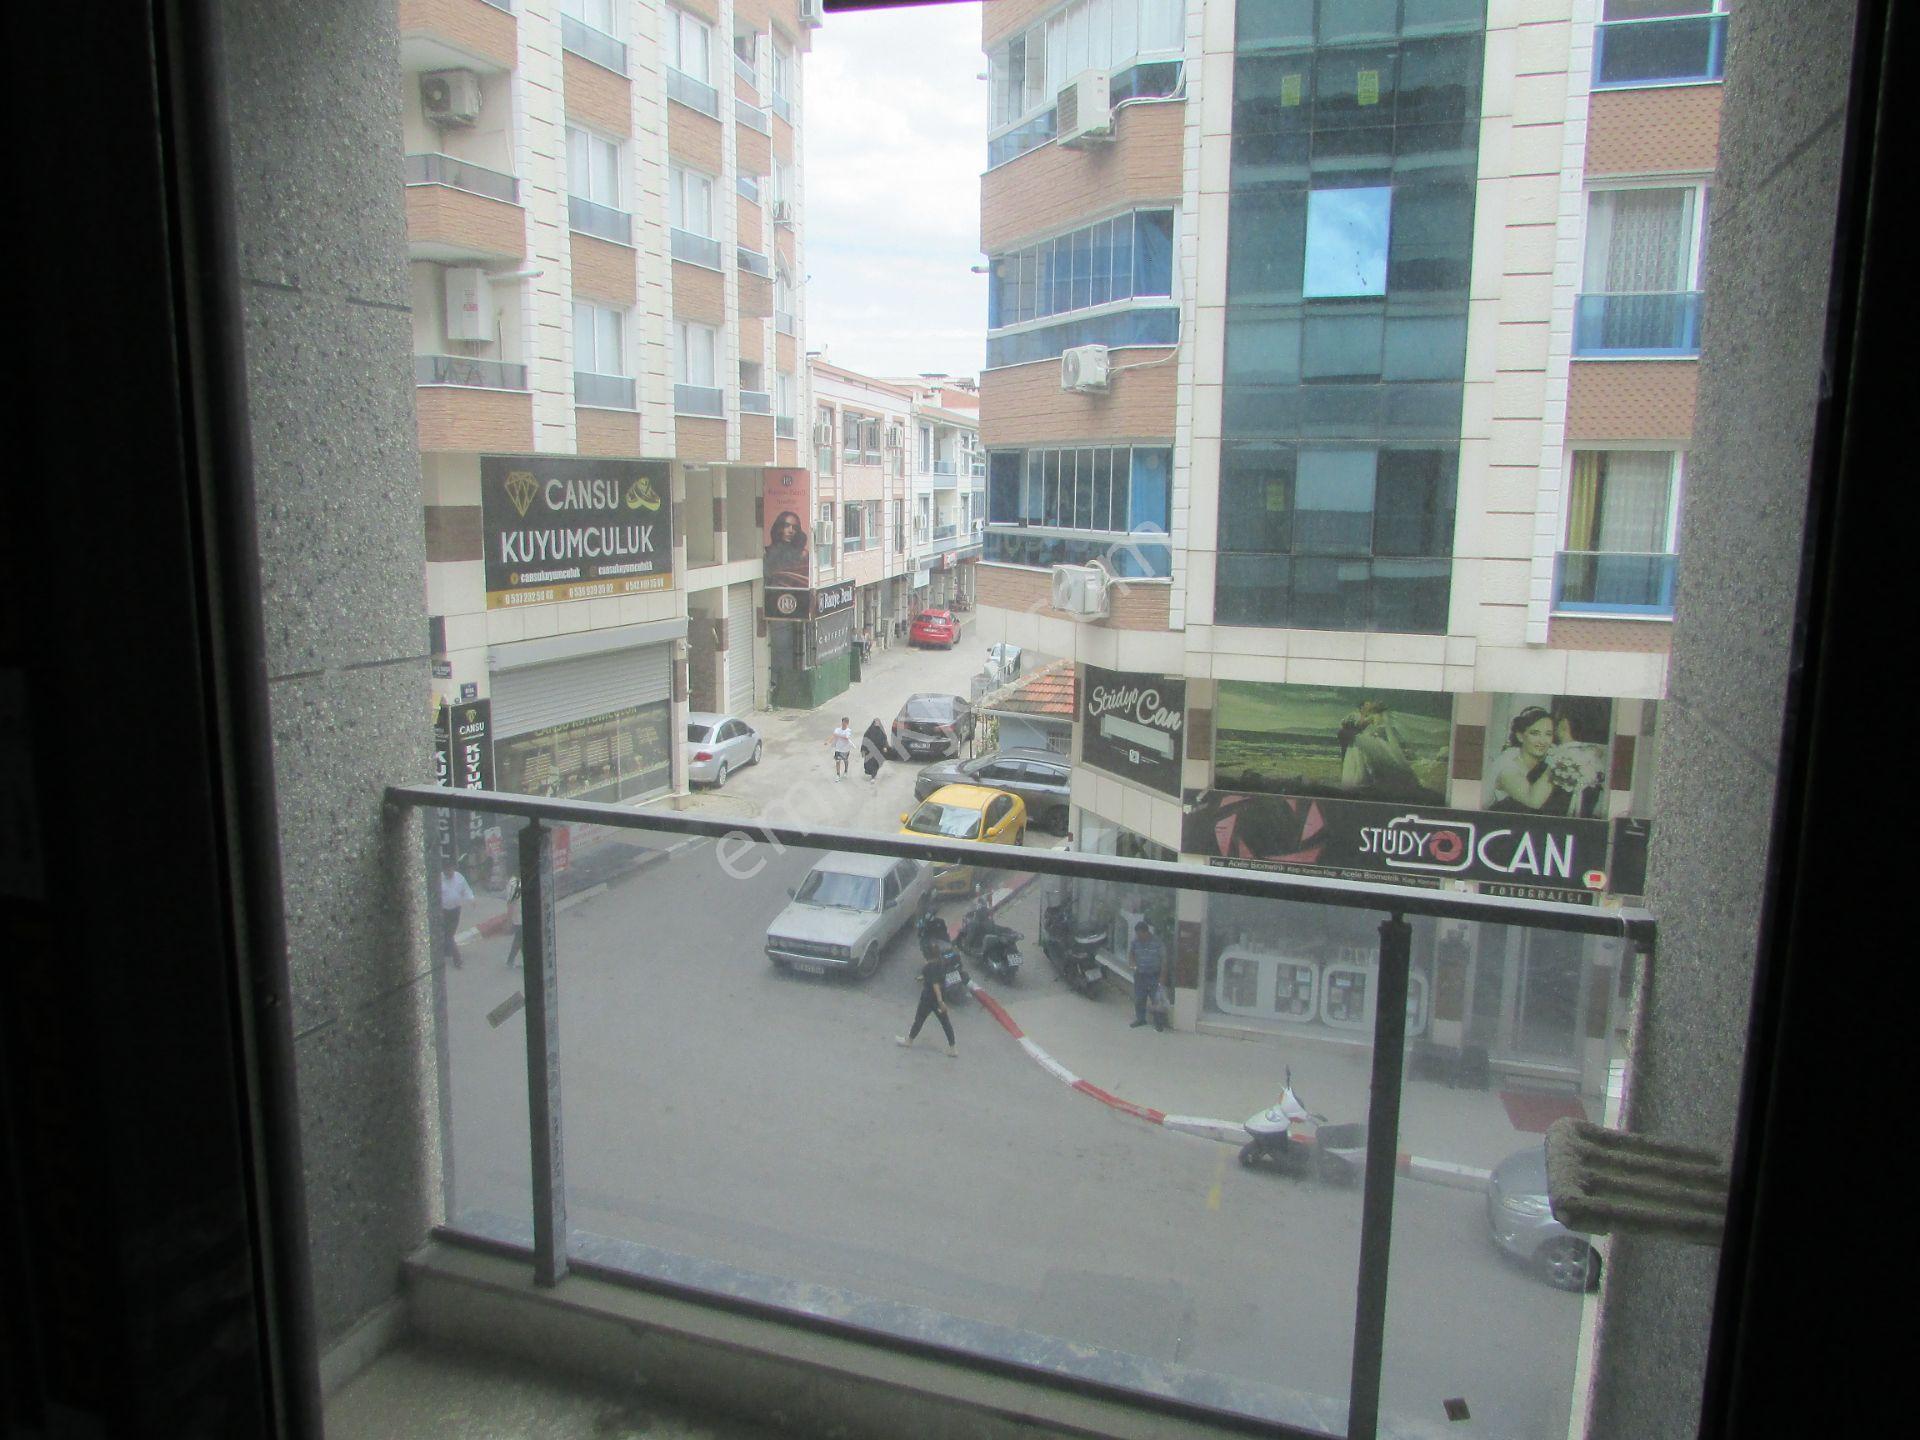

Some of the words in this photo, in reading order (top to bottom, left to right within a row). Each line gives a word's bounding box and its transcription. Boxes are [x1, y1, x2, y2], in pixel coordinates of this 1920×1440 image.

[545, 479, 620, 511] CANSU
[501, 525, 654, 564] KUYUMCULUK
[1088, 685, 1138, 716] Stüdyo
[1136, 689, 1182, 731] Can
[459, 721, 485, 735] CANSU
[1478, 828, 1576, 878] CAN
